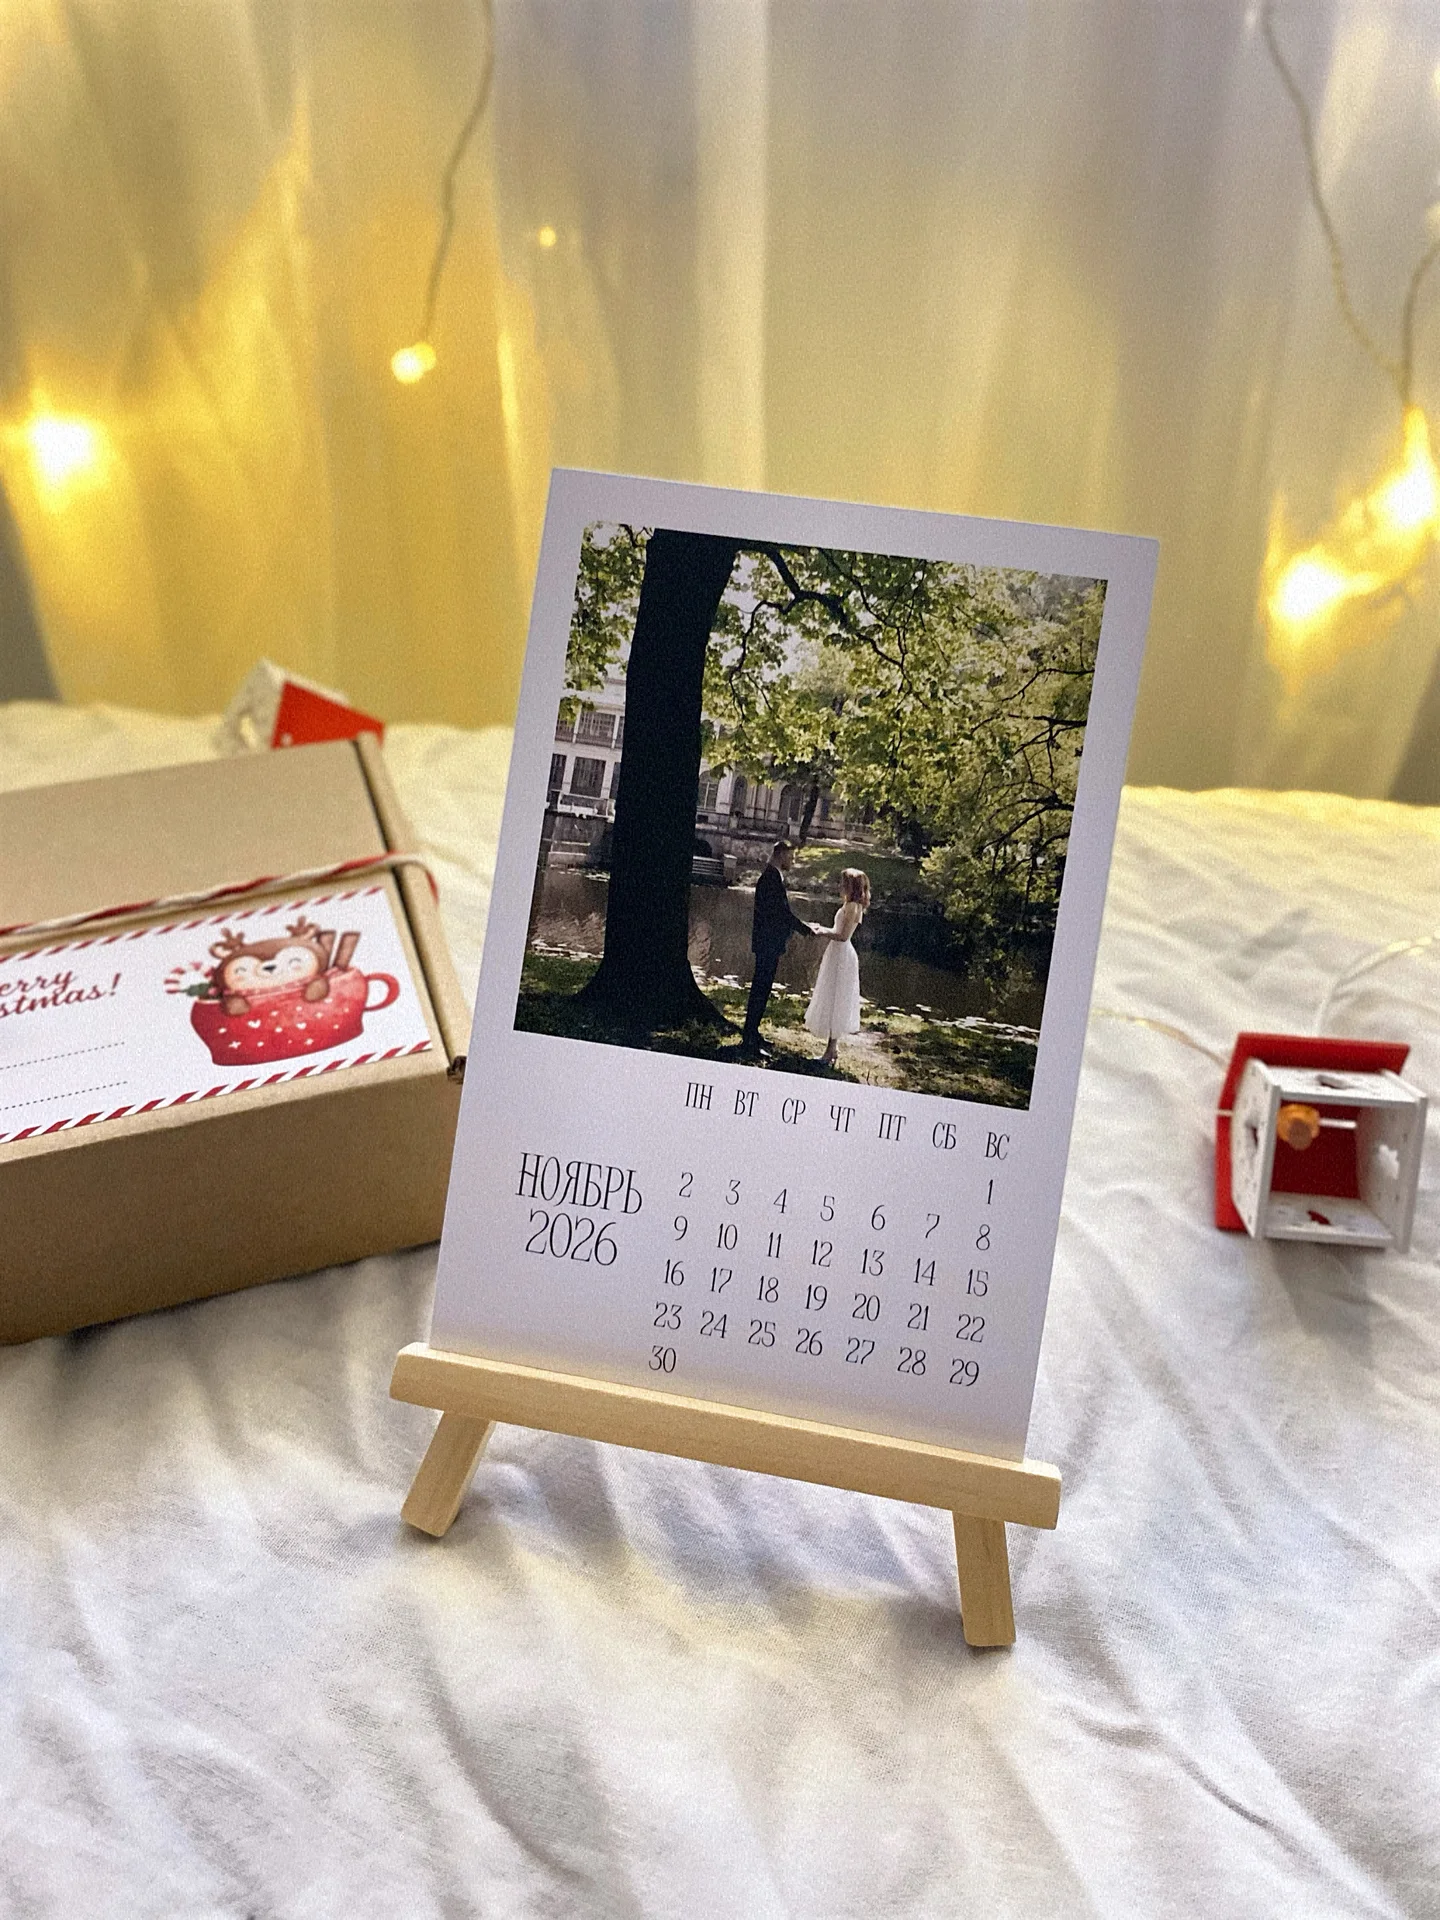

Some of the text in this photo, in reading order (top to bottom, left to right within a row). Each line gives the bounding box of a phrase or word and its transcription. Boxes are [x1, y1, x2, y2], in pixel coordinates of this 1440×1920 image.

[684, 1081, 1011, 1161] ПН ВТ СР ЧТ ПТ СБ ВС
[514, 1151, 643, 1215] НОЯБРЬ
[678, 1171, 991, 1252] 2 3 4 5 6 7 8
[986, 1178, 994, 1206] 1
[524, 1208, 618, 1267] 2026
[673, 1215, 989, 1298] 9 10 11 12 13 14 15
[663, 1258, 986, 1344] 16 17 18 19 20 21 22
[647, 1344, 677, 1374] 30
[652, 1301, 980, 1388] 23 24 25 26 27 28 29
